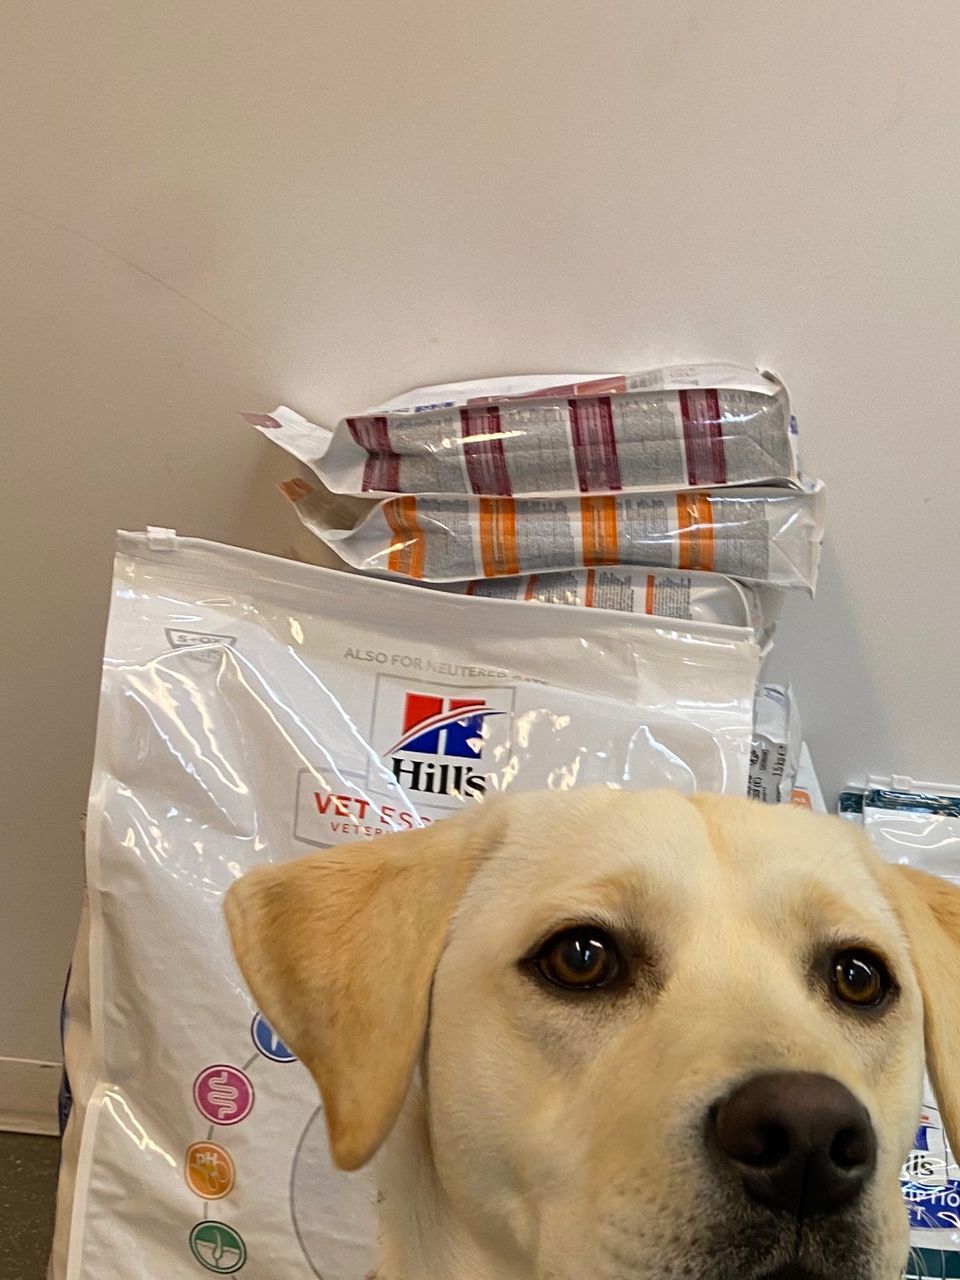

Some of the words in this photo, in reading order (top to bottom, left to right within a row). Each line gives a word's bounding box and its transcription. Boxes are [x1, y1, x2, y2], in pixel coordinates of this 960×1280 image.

[344, 647, 388, 664] ALSO
[391, 654, 423, 671] FOR
[426, 659, 509, 679] NEUTERED
[392, 757, 487, 799] Hill's
[313, 791, 371, 820] VET
